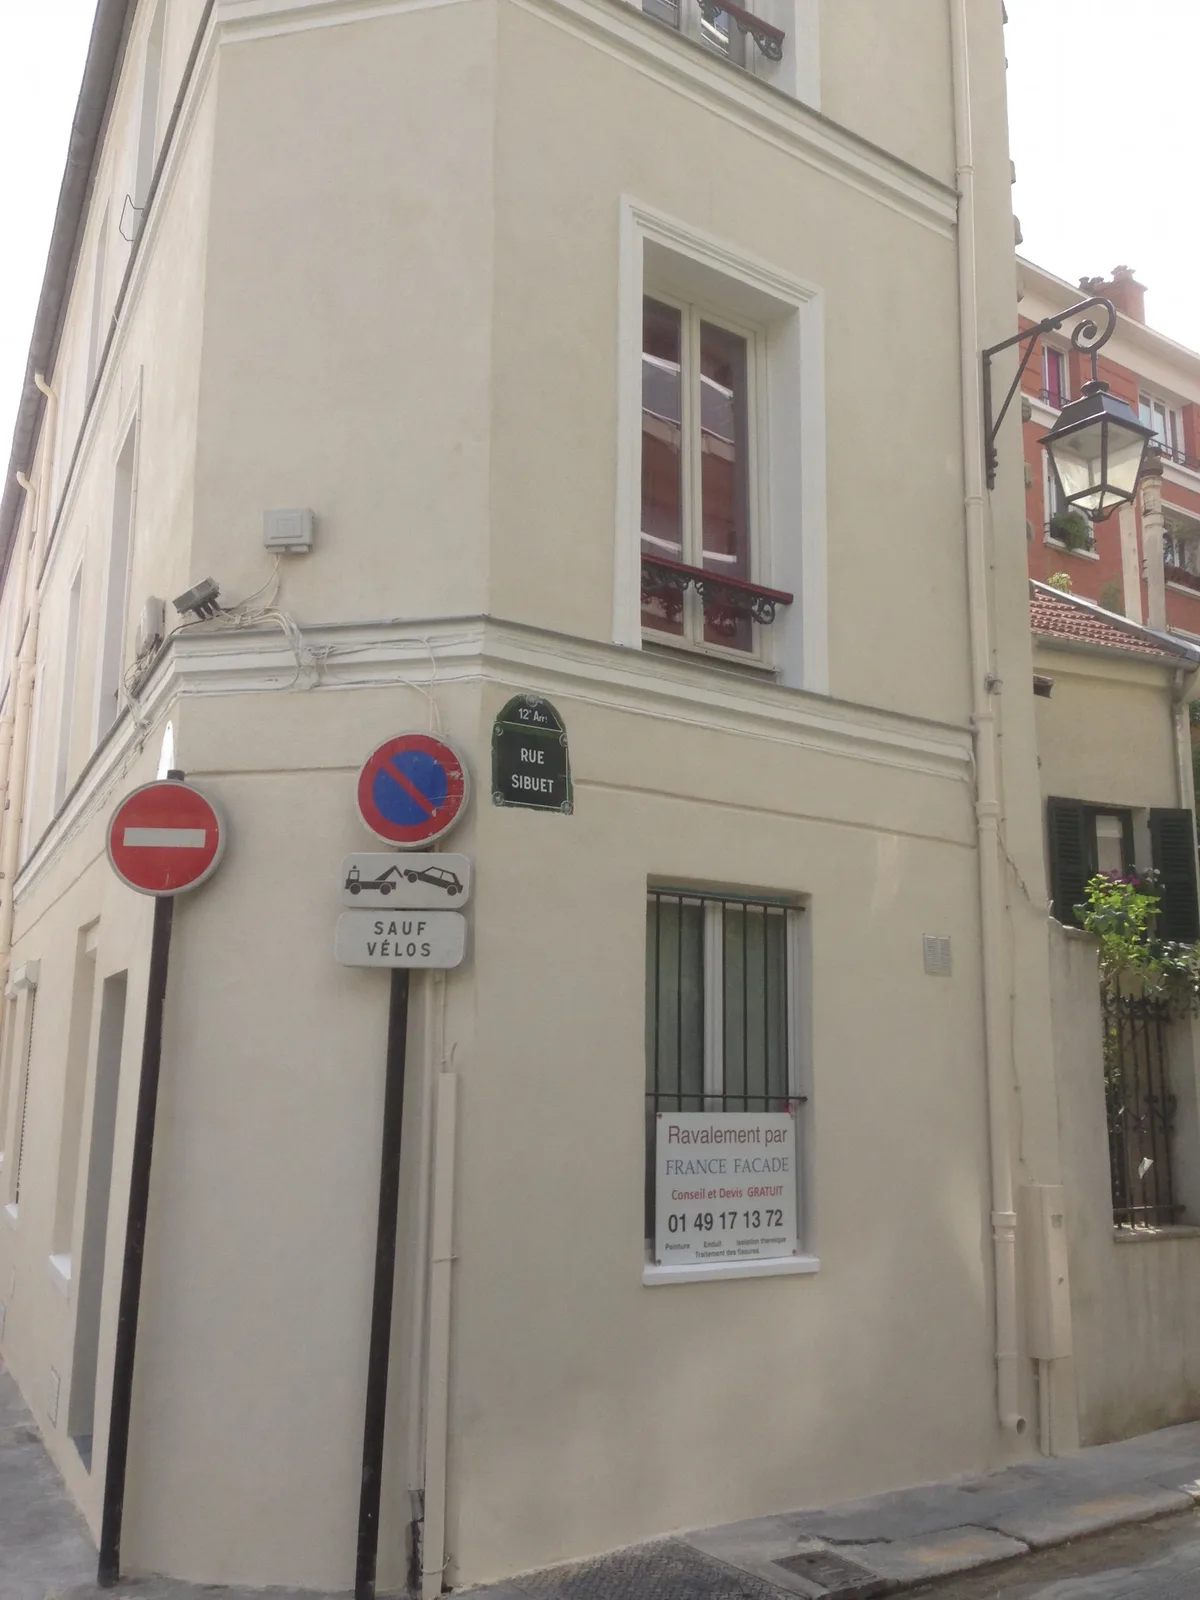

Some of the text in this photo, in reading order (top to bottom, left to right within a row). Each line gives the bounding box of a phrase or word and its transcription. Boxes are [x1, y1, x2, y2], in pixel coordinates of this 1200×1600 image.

[521, 748, 544, 764] RUE
[512, 774, 554, 793] SIBUET
[374, 921, 427, 935] SAUF
[367, 939, 431, 956] VÉLOS
[668, 1125, 787, 1146] Ravalement par
[666, 1159, 727, 1175] FRANCE
[672, 1186, 783, 1200] Conseil et Devis GRATUIT
[668, 1209, 783, 1233] 01 49 17 13 72
[760, 1237, 786, 1245] thermique
